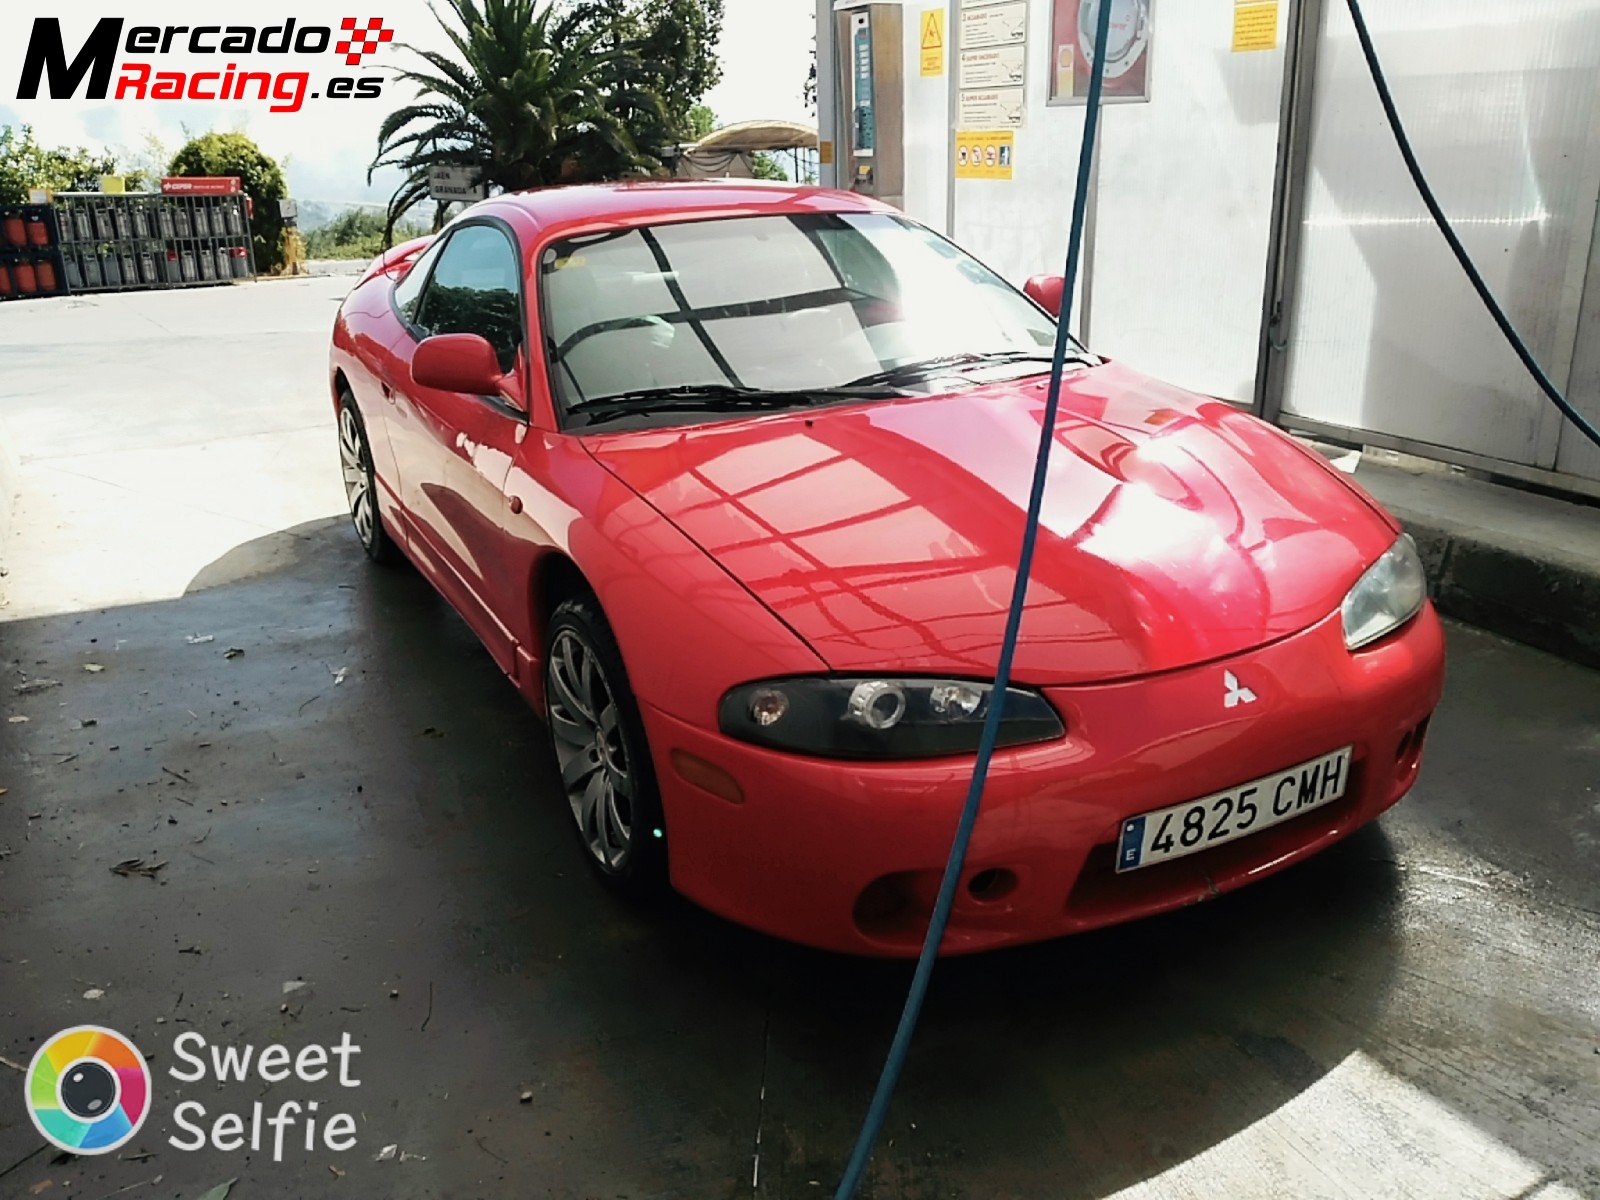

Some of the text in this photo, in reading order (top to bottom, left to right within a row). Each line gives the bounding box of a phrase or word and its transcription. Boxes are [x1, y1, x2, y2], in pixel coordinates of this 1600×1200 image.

[1151, 755, 1342, 854] 4825 CMH
[1125, 848, 1136, 861] E
